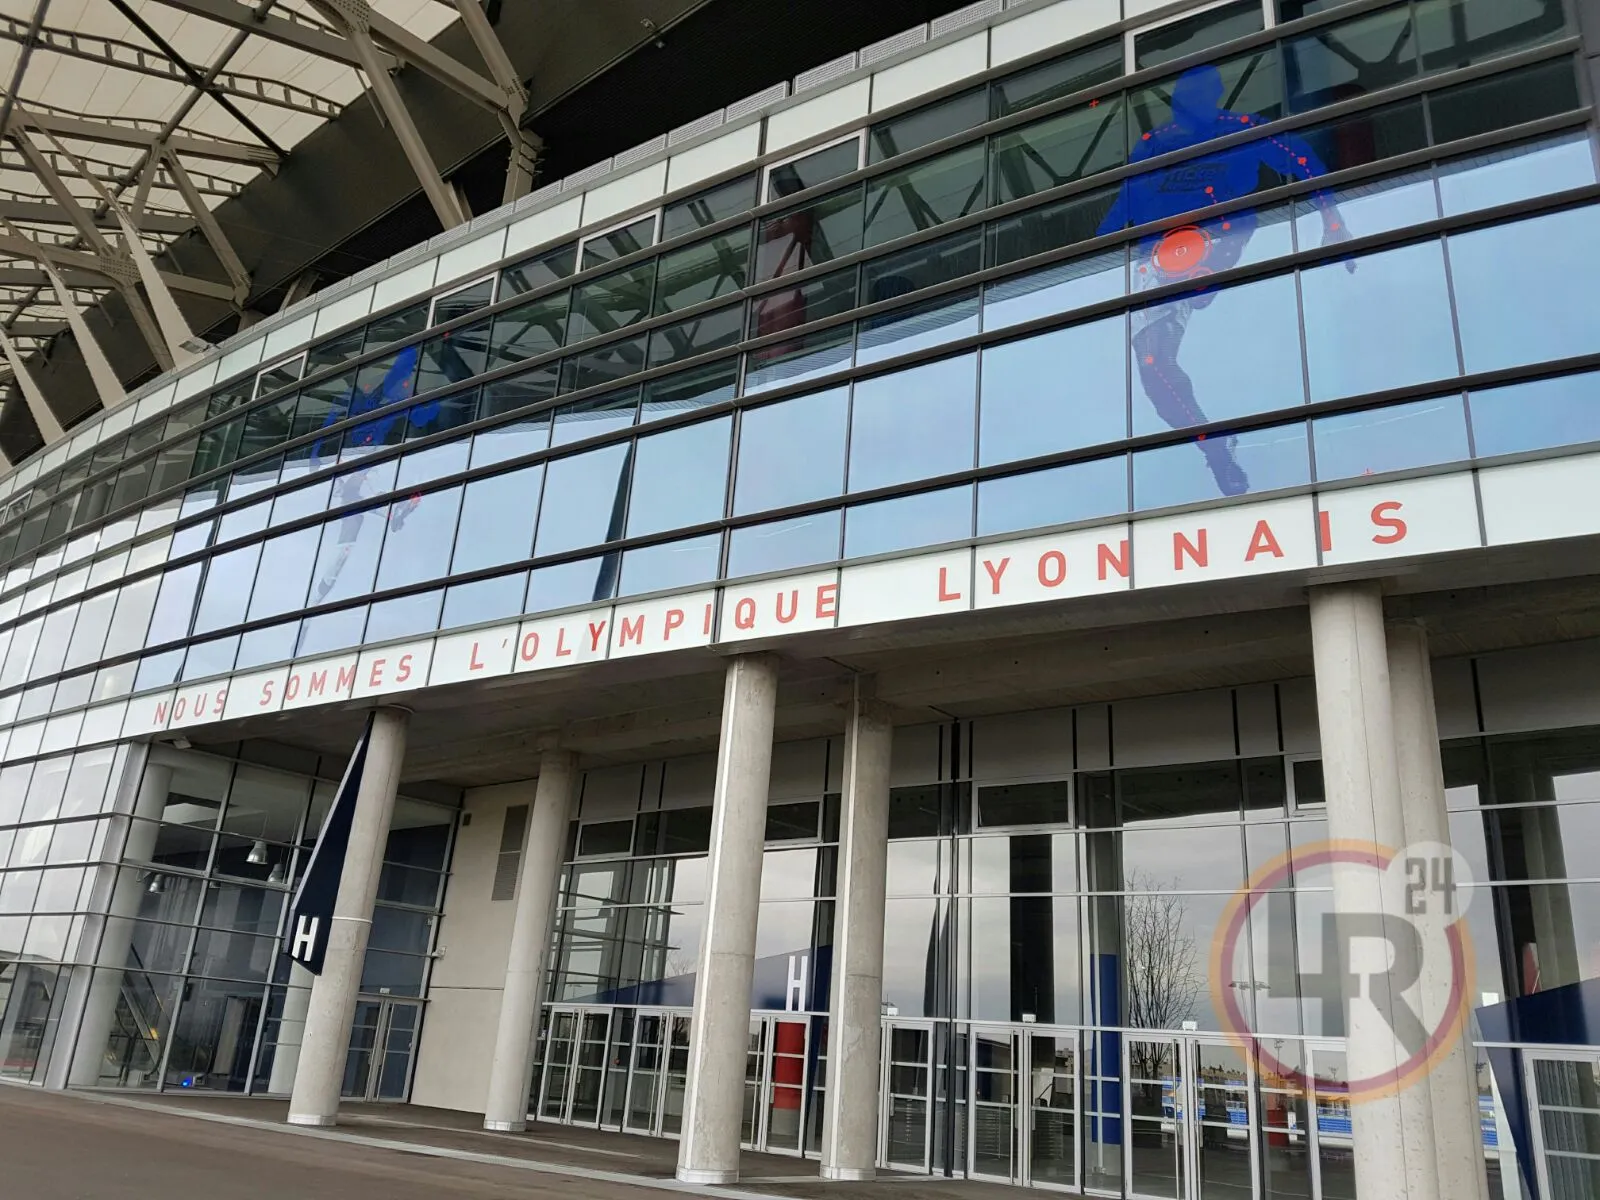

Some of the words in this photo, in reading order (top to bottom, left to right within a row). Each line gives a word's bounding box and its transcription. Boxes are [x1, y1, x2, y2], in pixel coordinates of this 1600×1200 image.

[153, 689, 227, 725] NOUS
[259, 654, 413, 706] SOMMES
[469, 583, 838, 671] L'OLYMPIQUE
[938, 501, 1408, 602] LYONNAIS
[291, 914, 320, 962] H
[785, 955, 808, 1012] H
